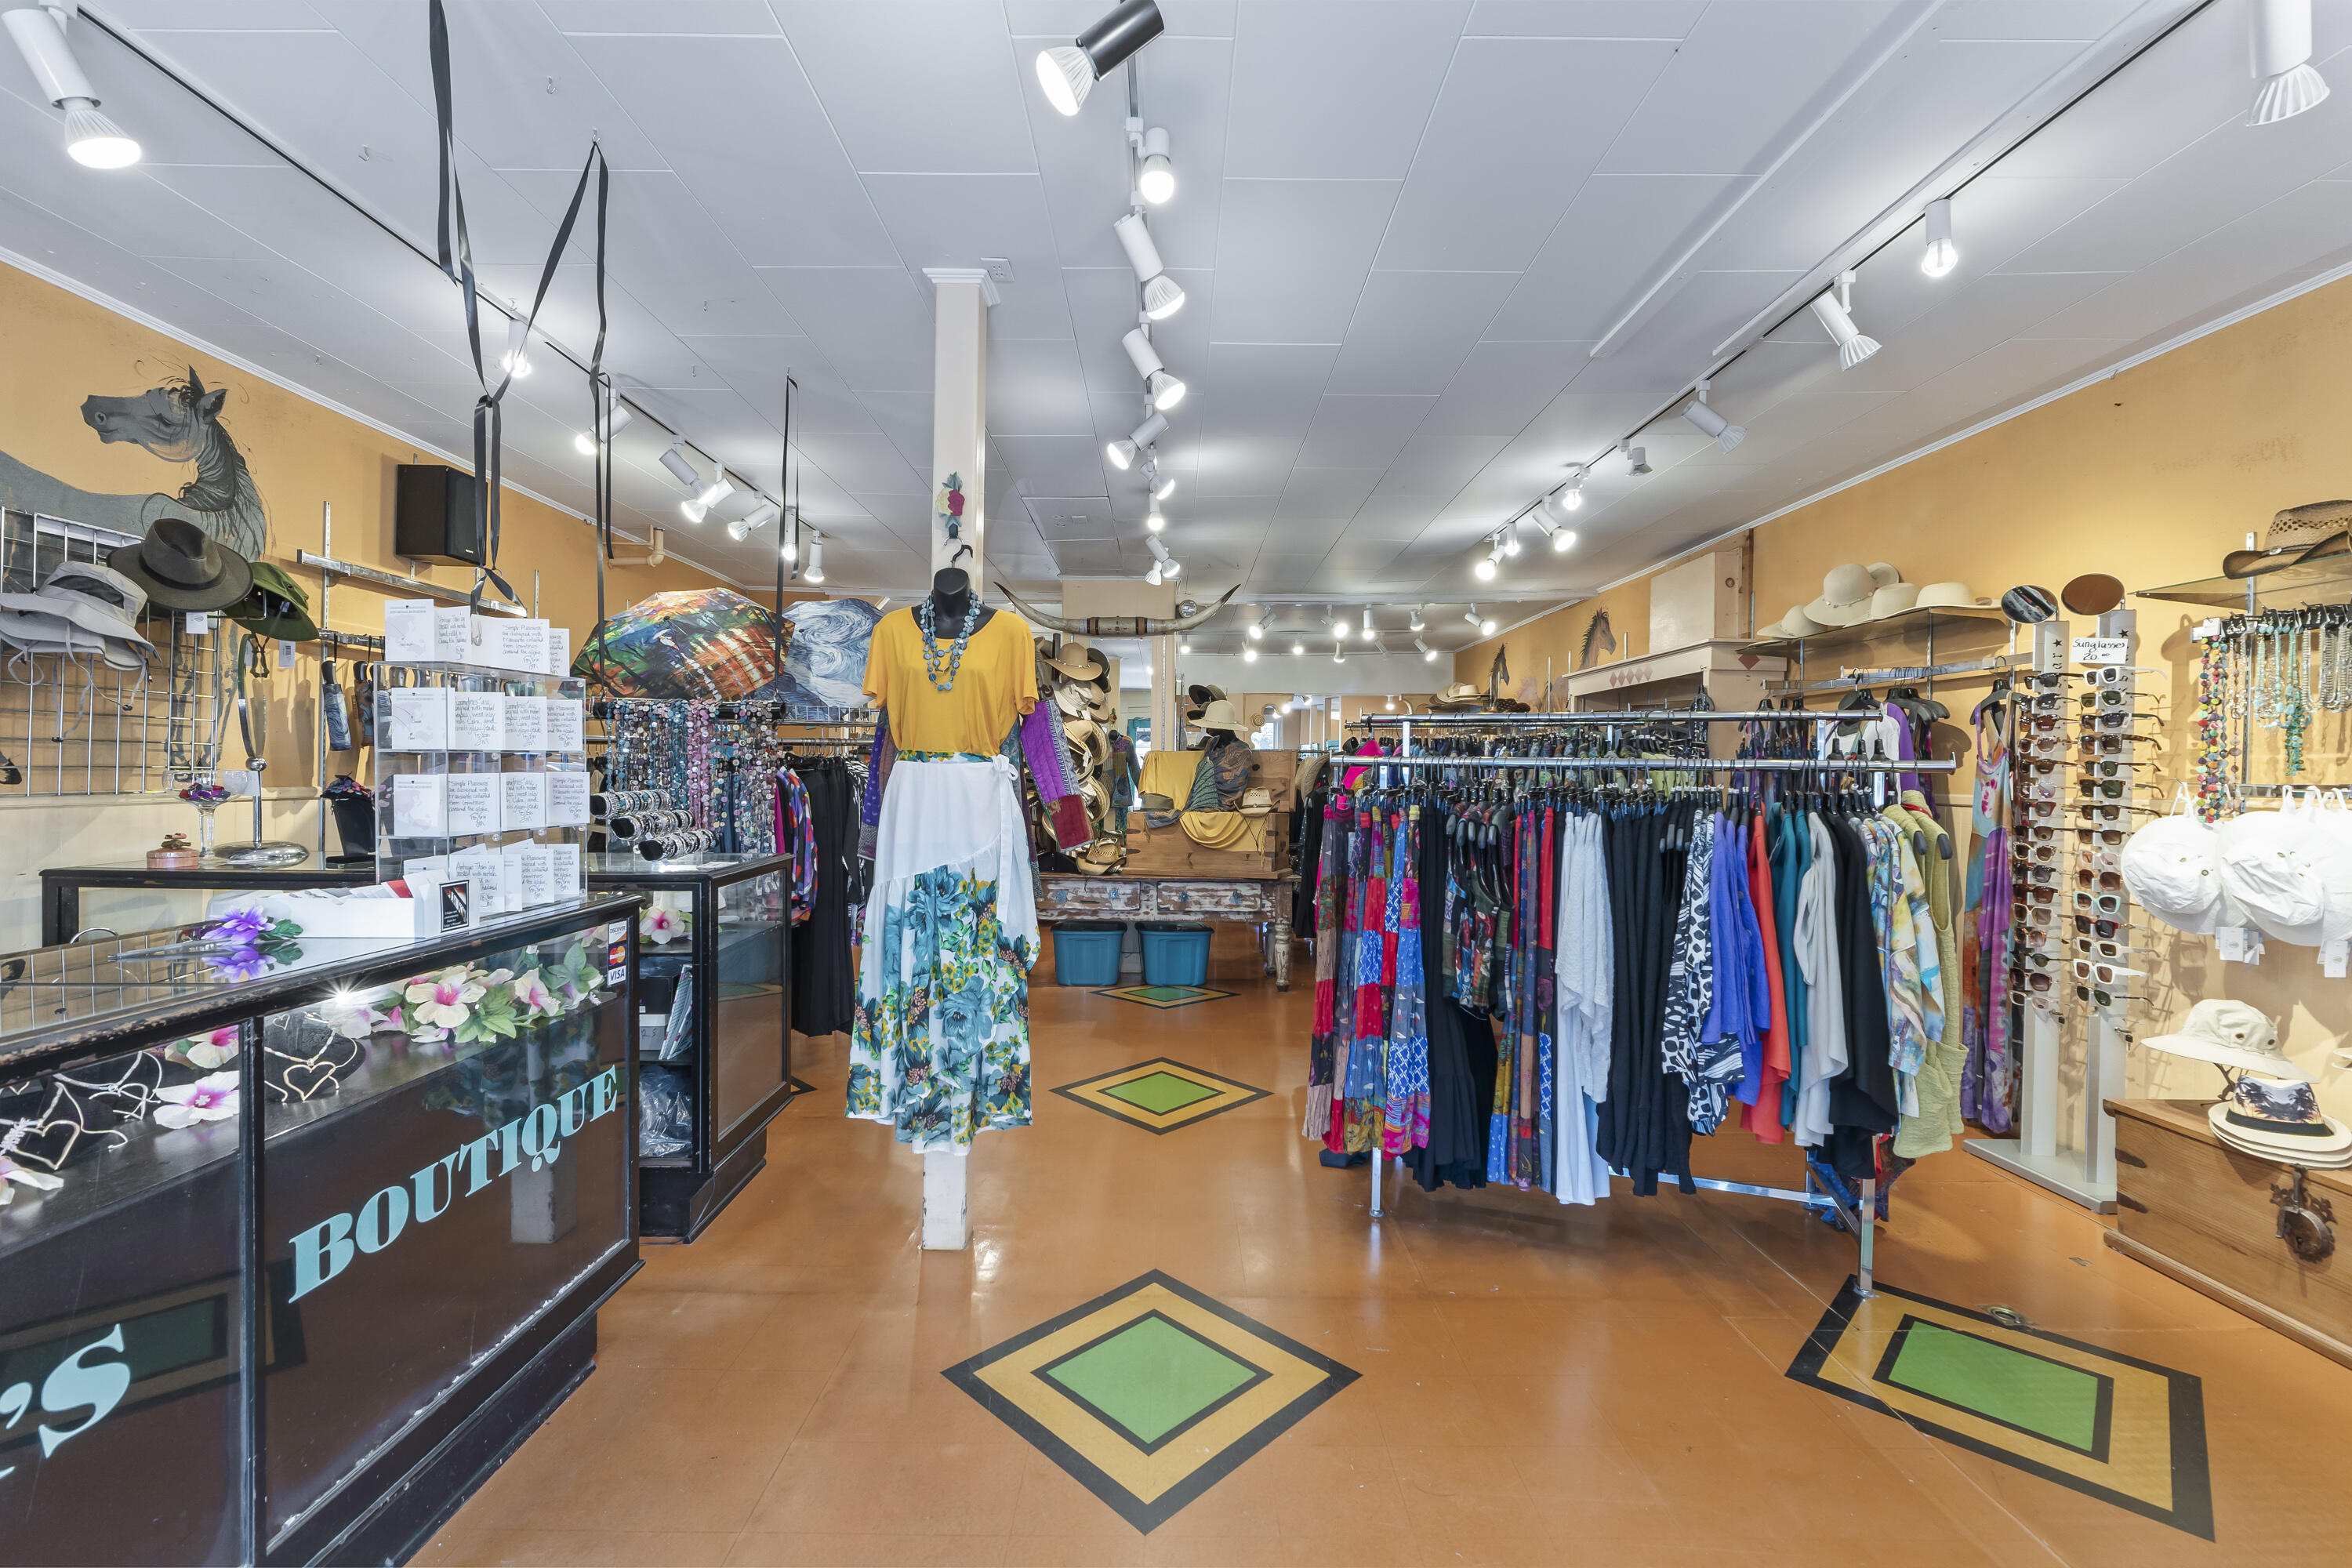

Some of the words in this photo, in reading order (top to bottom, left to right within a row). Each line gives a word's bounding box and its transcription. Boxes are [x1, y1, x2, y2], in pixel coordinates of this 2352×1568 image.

[2073, 639, 2125, 653] Sunglasses
[610, 968, 625, 981] VISA
[289, 1064, 618, 1304] BOUTIQUE
